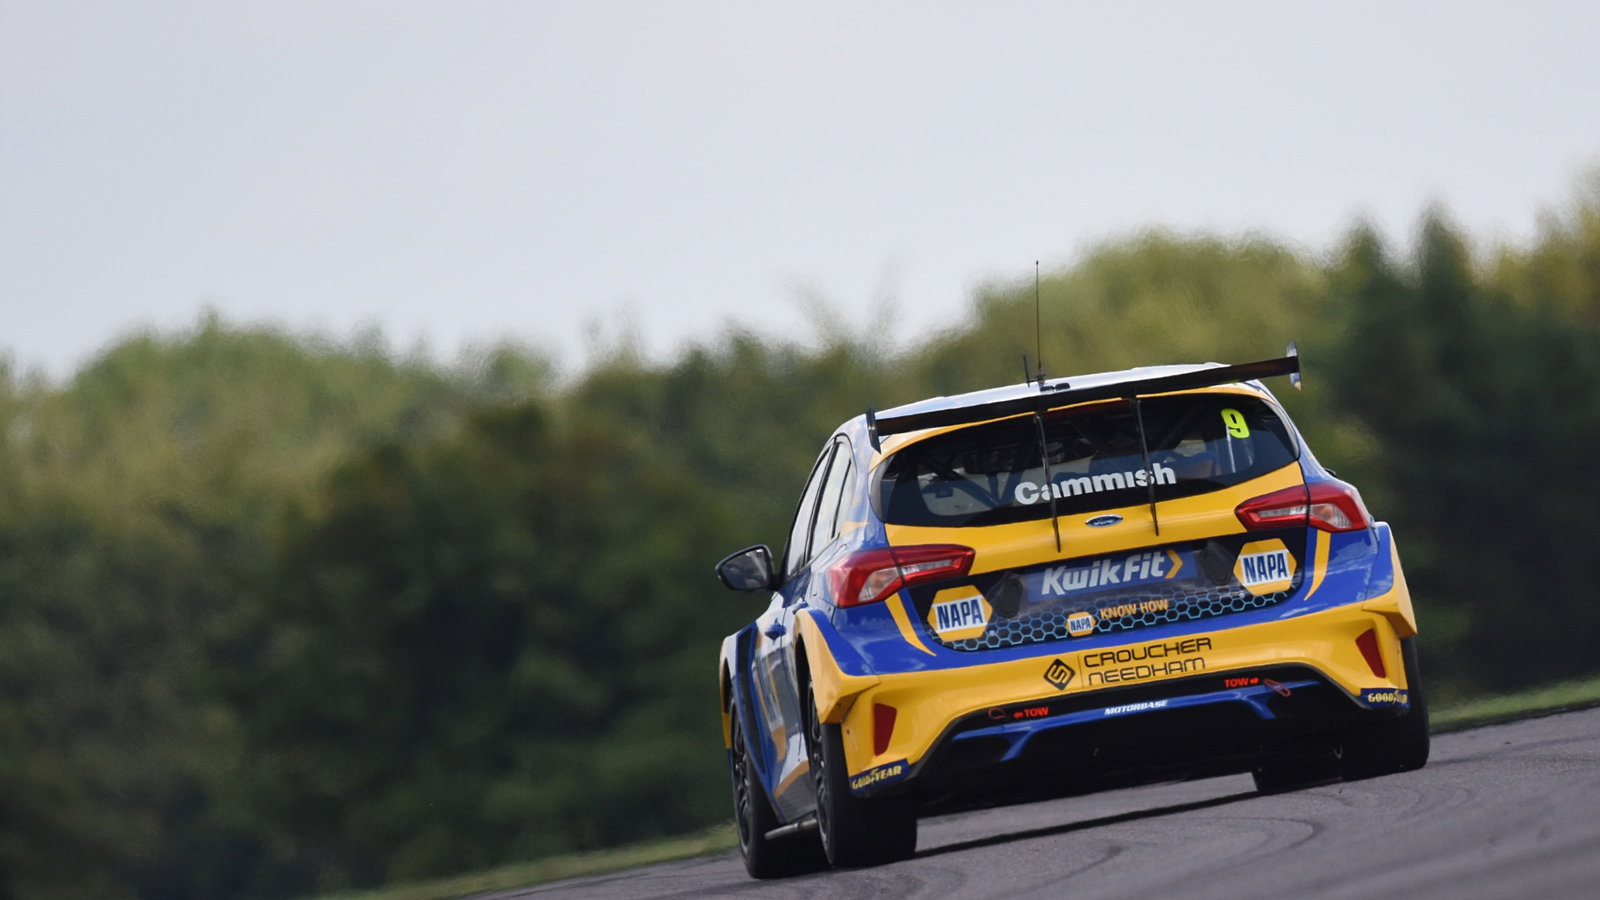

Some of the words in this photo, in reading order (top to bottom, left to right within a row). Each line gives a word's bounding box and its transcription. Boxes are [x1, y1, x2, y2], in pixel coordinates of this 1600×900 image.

[1221, 408, 1250, 439] 9
[1014, 463, 1176, 505] Cammish
[1243, 552, 1288, 583] NAPA
[937, 599, 984, 630] NAPA
[1100, 603, 1137, 619] KNOW
[1140, 599, 1169, 613] HOW
[1070, 617, 1092, 632] NAPA
[1084, 637, 1212, 668] CROUCHER
[1088, 657, 1206, 686] NEEDHAM
[1224, 677, 1249, 688] TOW
[1023, 707, 1048, 718] TOW
[1104, 699, 1168, 716] MOTORBASE
